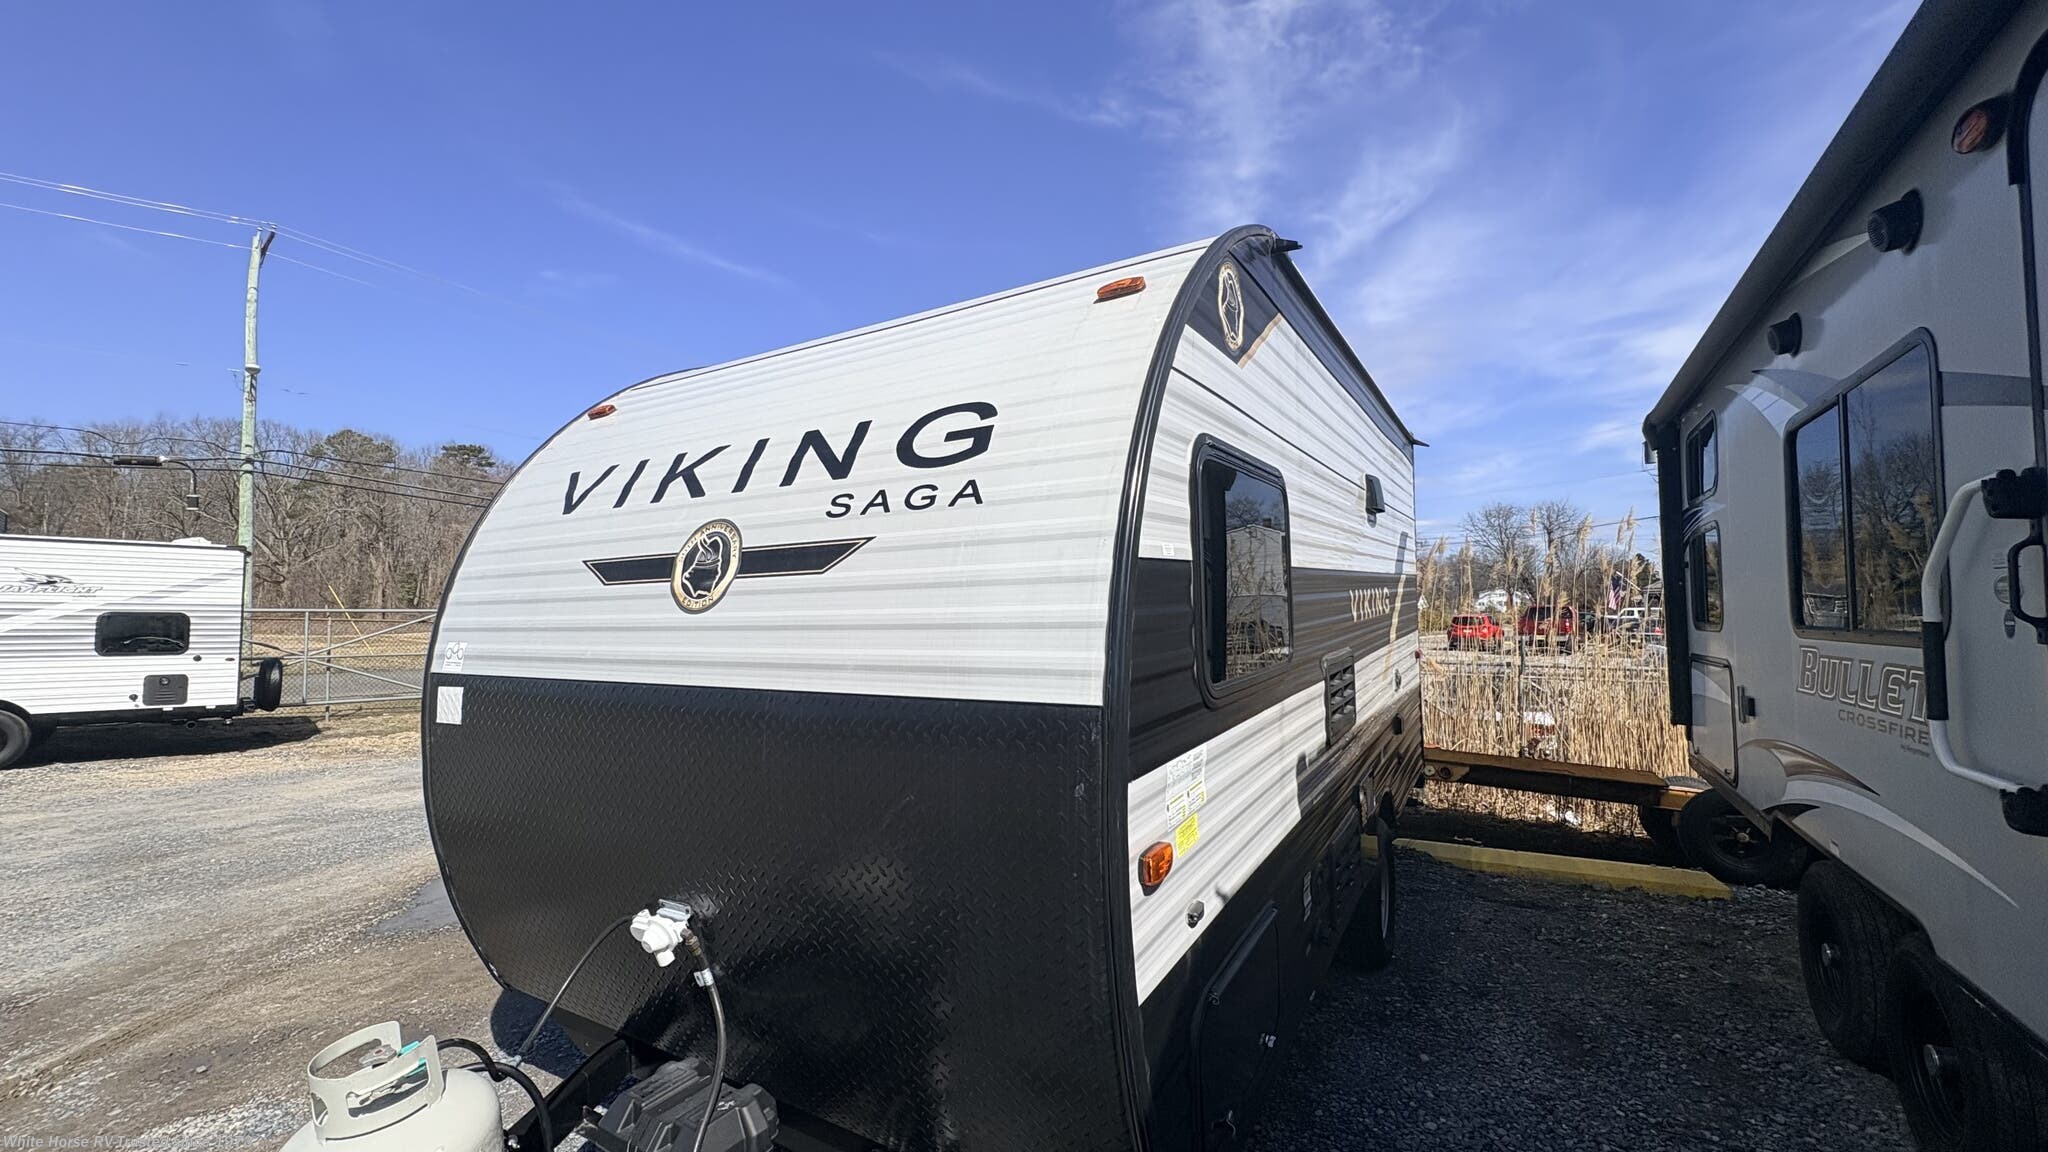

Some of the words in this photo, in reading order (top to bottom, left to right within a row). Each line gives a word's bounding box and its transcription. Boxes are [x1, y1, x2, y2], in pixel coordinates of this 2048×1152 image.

[562, 402, 999, 515] VIKING
[825, 480, 985, 518] SAGA
[681, 595, 714, 608] EDITION
[1349, 586, 1390, 623] VIKING
[1838, 709, 1930, 746] CROSSFIRE
